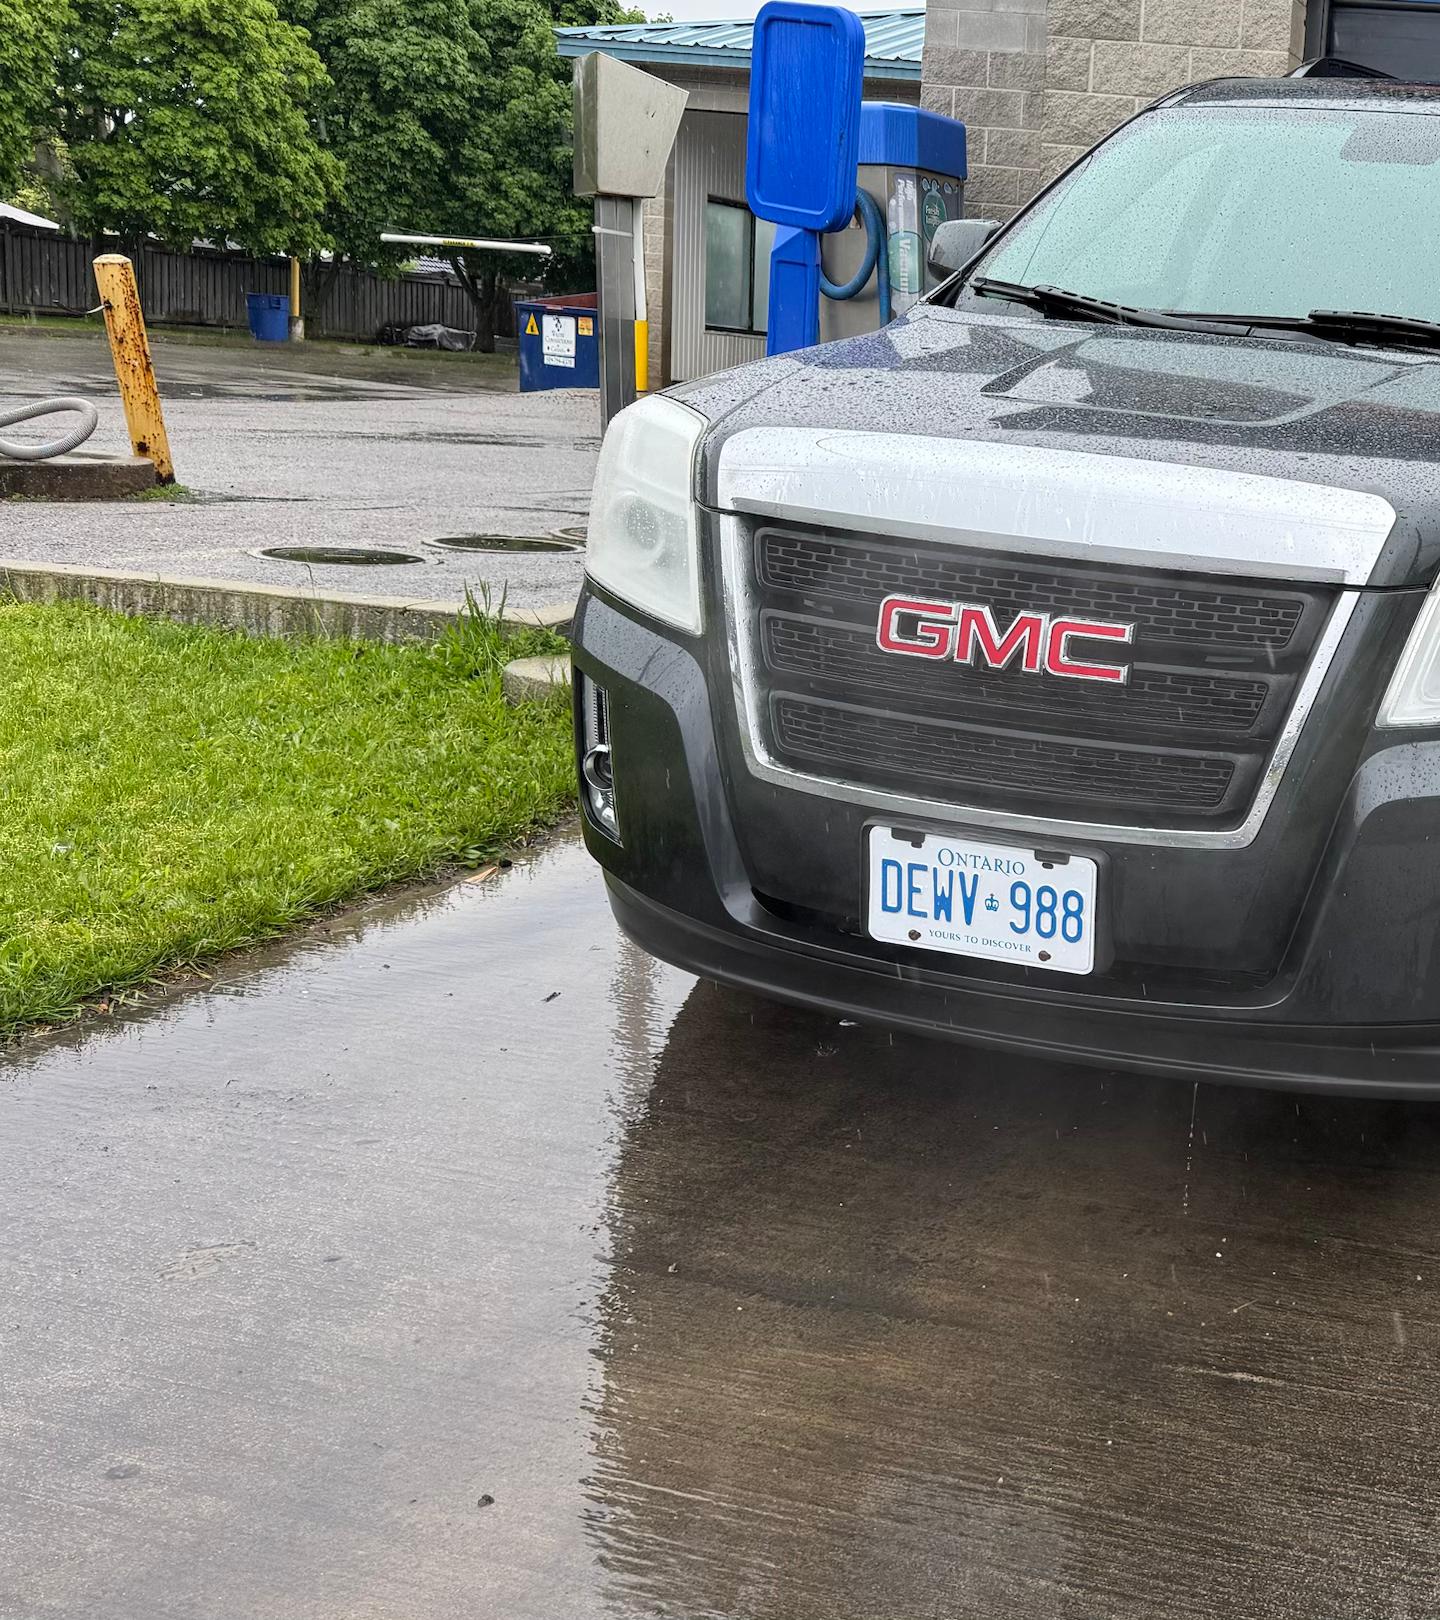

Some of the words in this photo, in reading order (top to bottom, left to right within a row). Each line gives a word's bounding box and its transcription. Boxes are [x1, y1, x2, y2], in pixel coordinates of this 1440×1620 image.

[876, 592, 1136, 685] GMC
[938, 848, 1025, 876] ONTARIO
[881, 858, 979, 926] DEWV
[1009, 880, 1084, 943] 988
[929, 929, 960, 941] YOURS
[965, 935, 978, 944] TO
[982, 938, 1031, 952] DISCOVER
